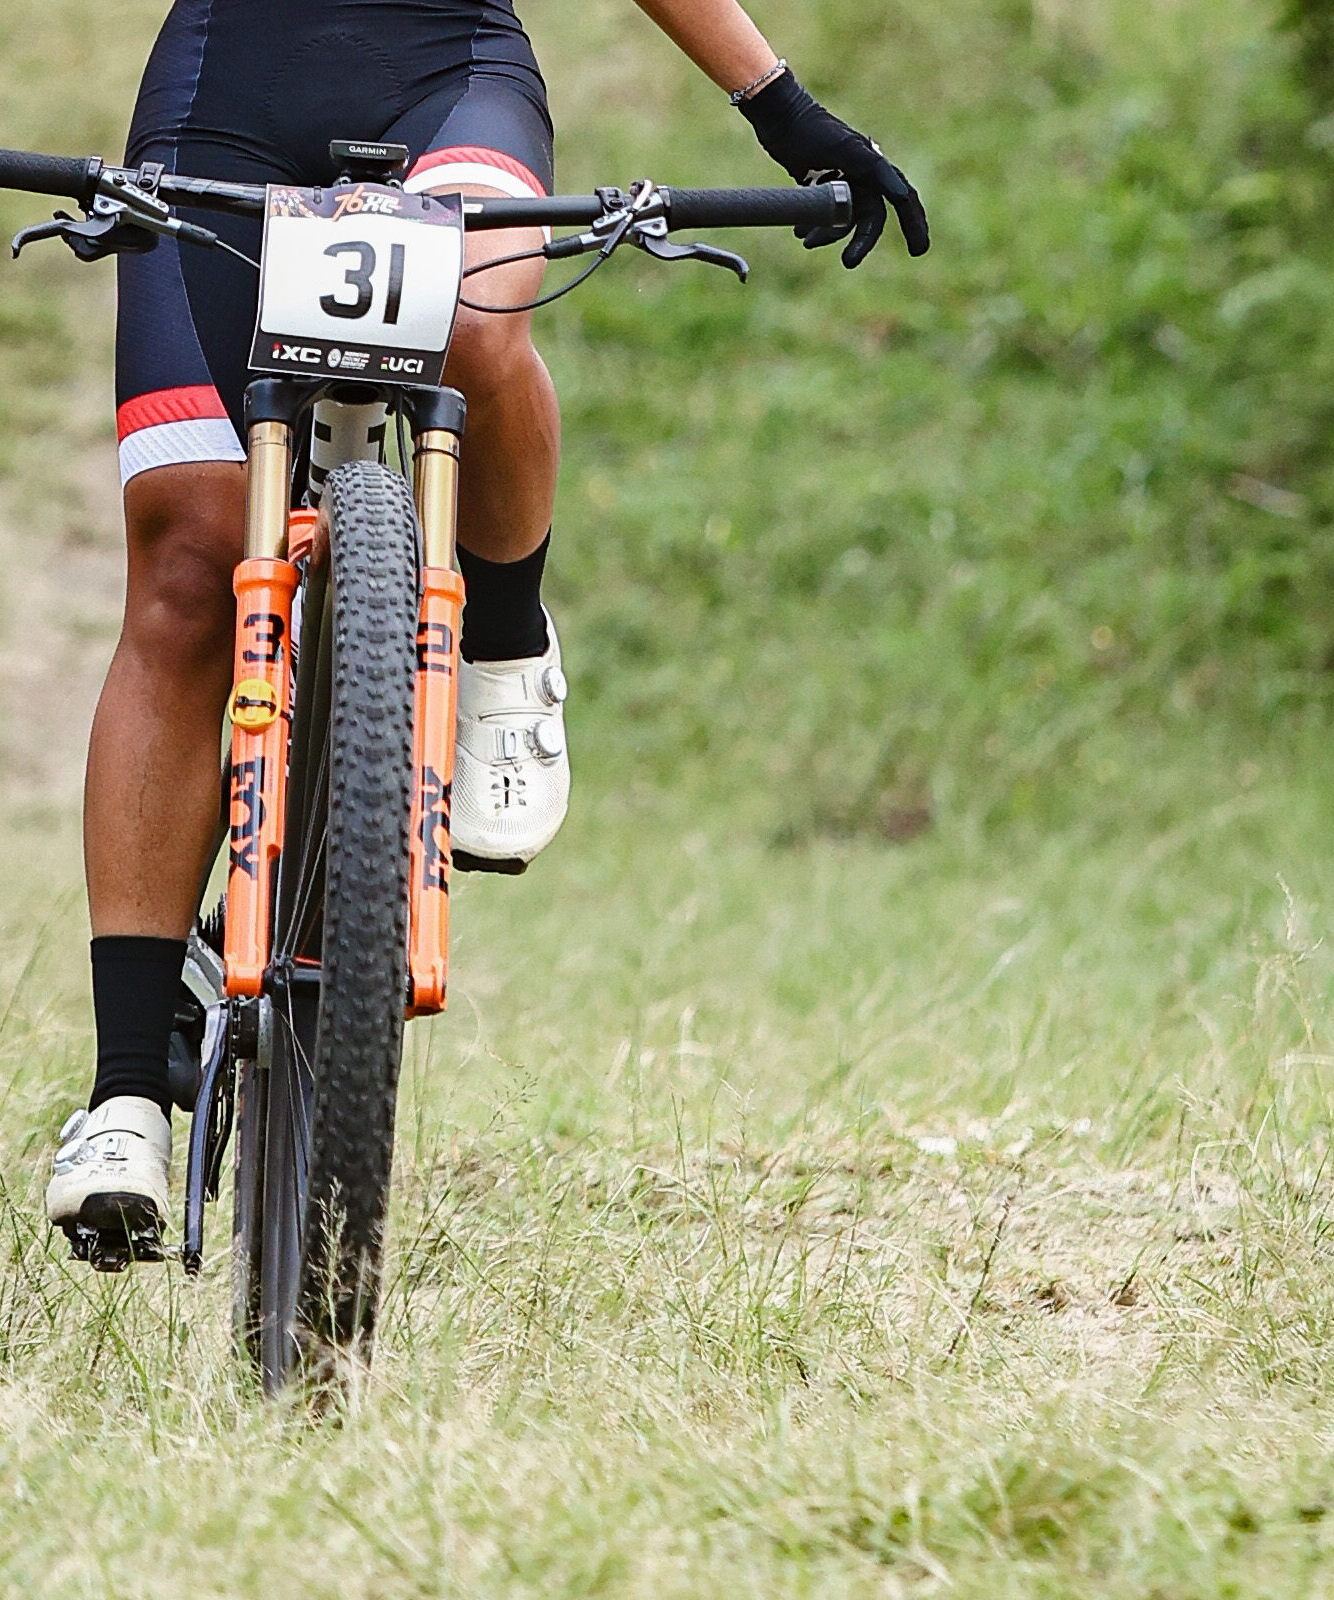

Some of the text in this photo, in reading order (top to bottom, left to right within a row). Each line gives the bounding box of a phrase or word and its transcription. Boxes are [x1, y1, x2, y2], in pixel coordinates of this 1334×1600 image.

[348, 145, 387, 156] GARMIN
[319, 240, 406, 325] 31
[388, 356, 424, 374] UCI
[229, 756, 267, 880] FOX
[418, 766, 452, 895] FOX
